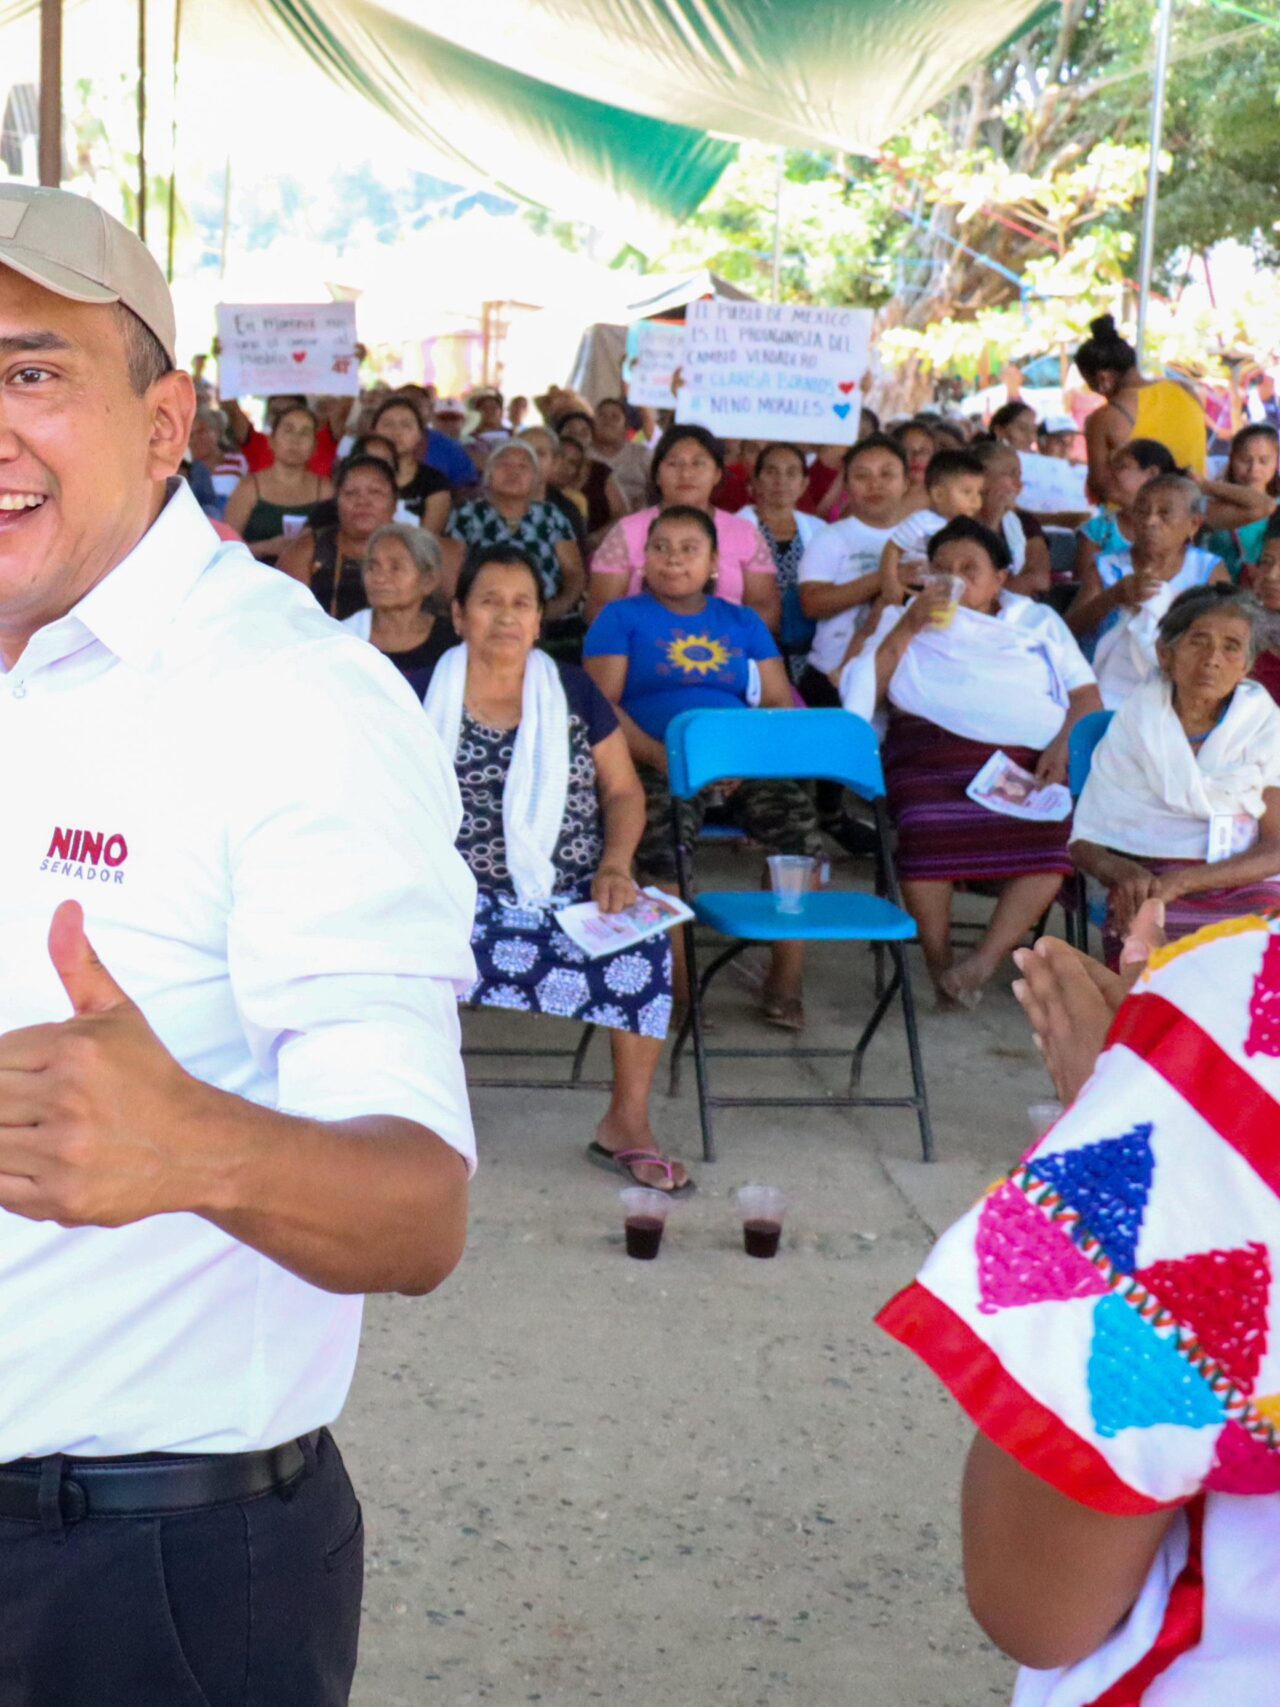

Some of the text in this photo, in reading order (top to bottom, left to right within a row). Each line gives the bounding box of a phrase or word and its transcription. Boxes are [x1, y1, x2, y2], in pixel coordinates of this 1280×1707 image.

[758, 396, 825, 416] MORALES
[46, 826, 128, 867] NINO
[39, 858, 125, 884] SENADOR
